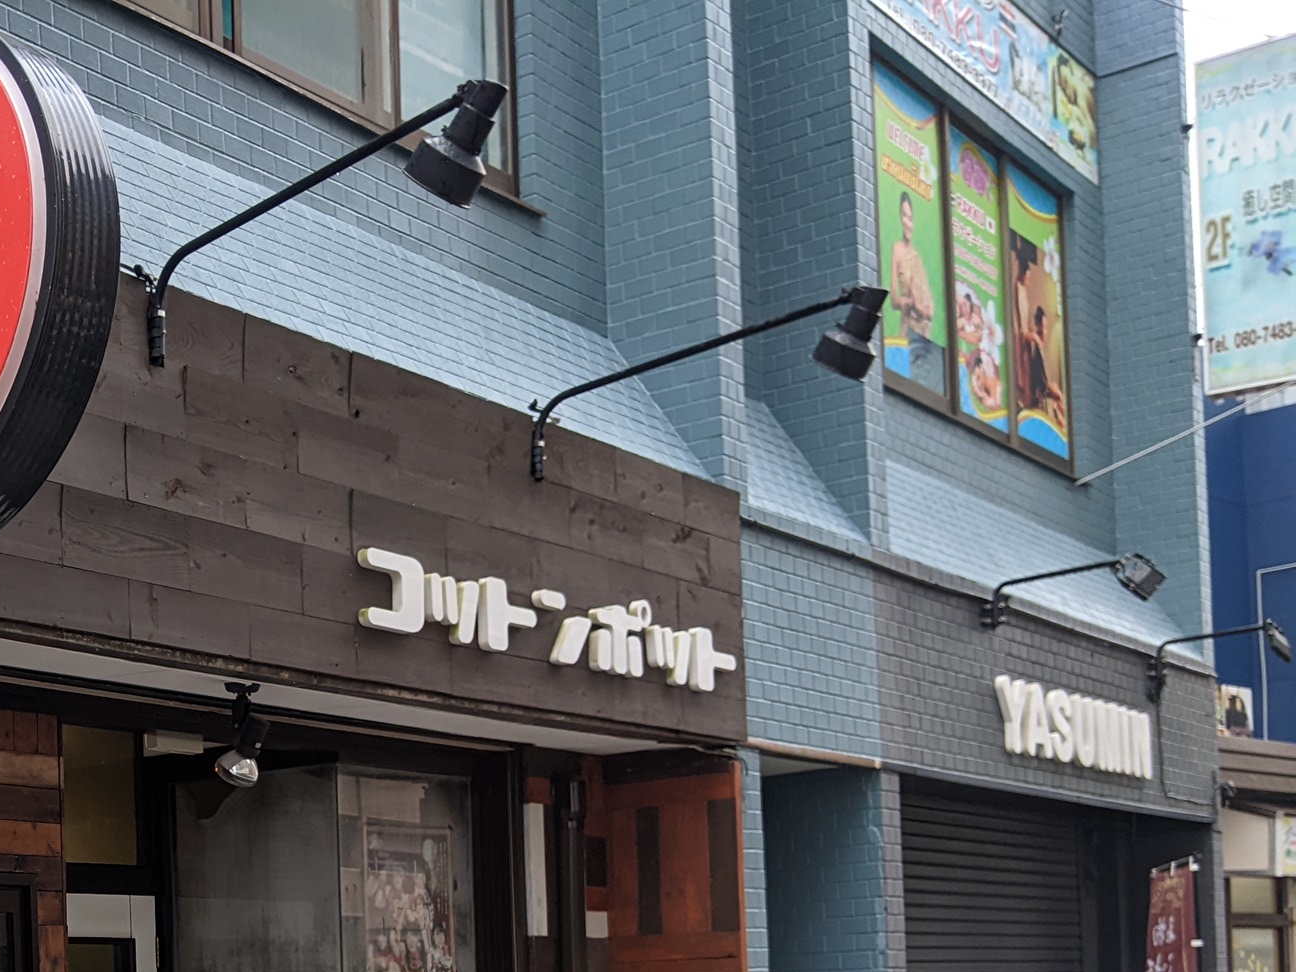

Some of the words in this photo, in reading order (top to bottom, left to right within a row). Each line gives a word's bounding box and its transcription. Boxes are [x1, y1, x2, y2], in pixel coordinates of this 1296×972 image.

[1206, 213, 1233, 264] 2F
[357, 547, 737, 692] コットンポット
[994, 674, 1152, 780] YASUMIN
